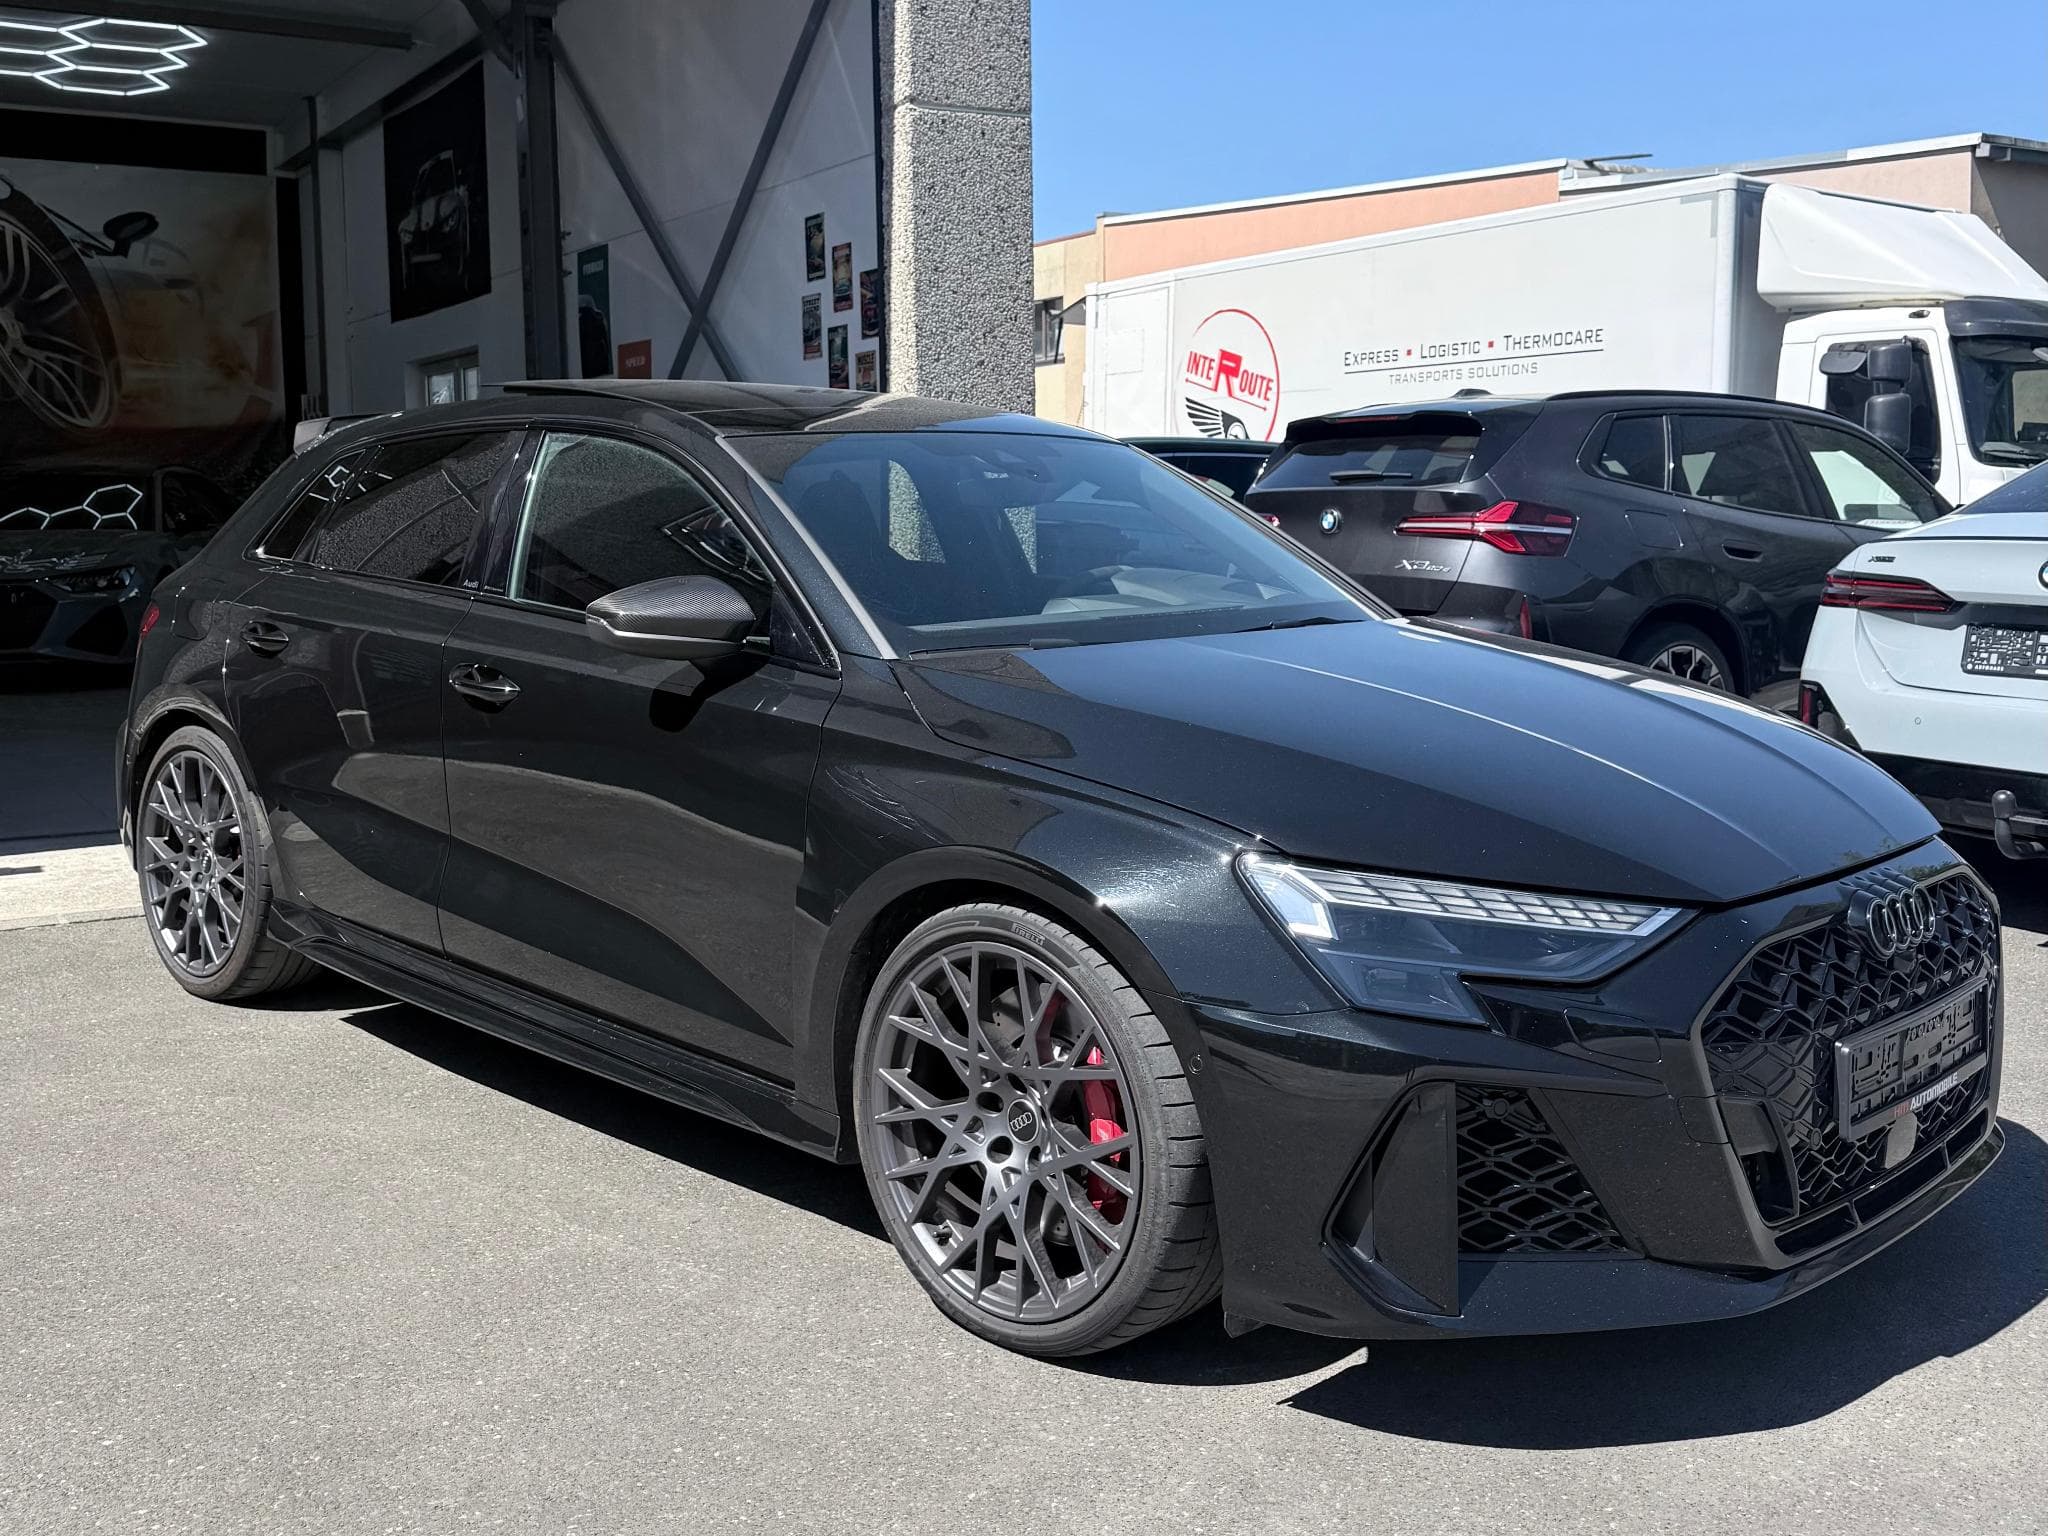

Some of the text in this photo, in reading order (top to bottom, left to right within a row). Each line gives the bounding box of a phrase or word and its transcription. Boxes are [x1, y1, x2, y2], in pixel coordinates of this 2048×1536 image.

[1389, 362, 1538, 385] TRANSPORTS SOLUTIONS
[1910, 1071, 1958, 1111] AUTOMOBILE
